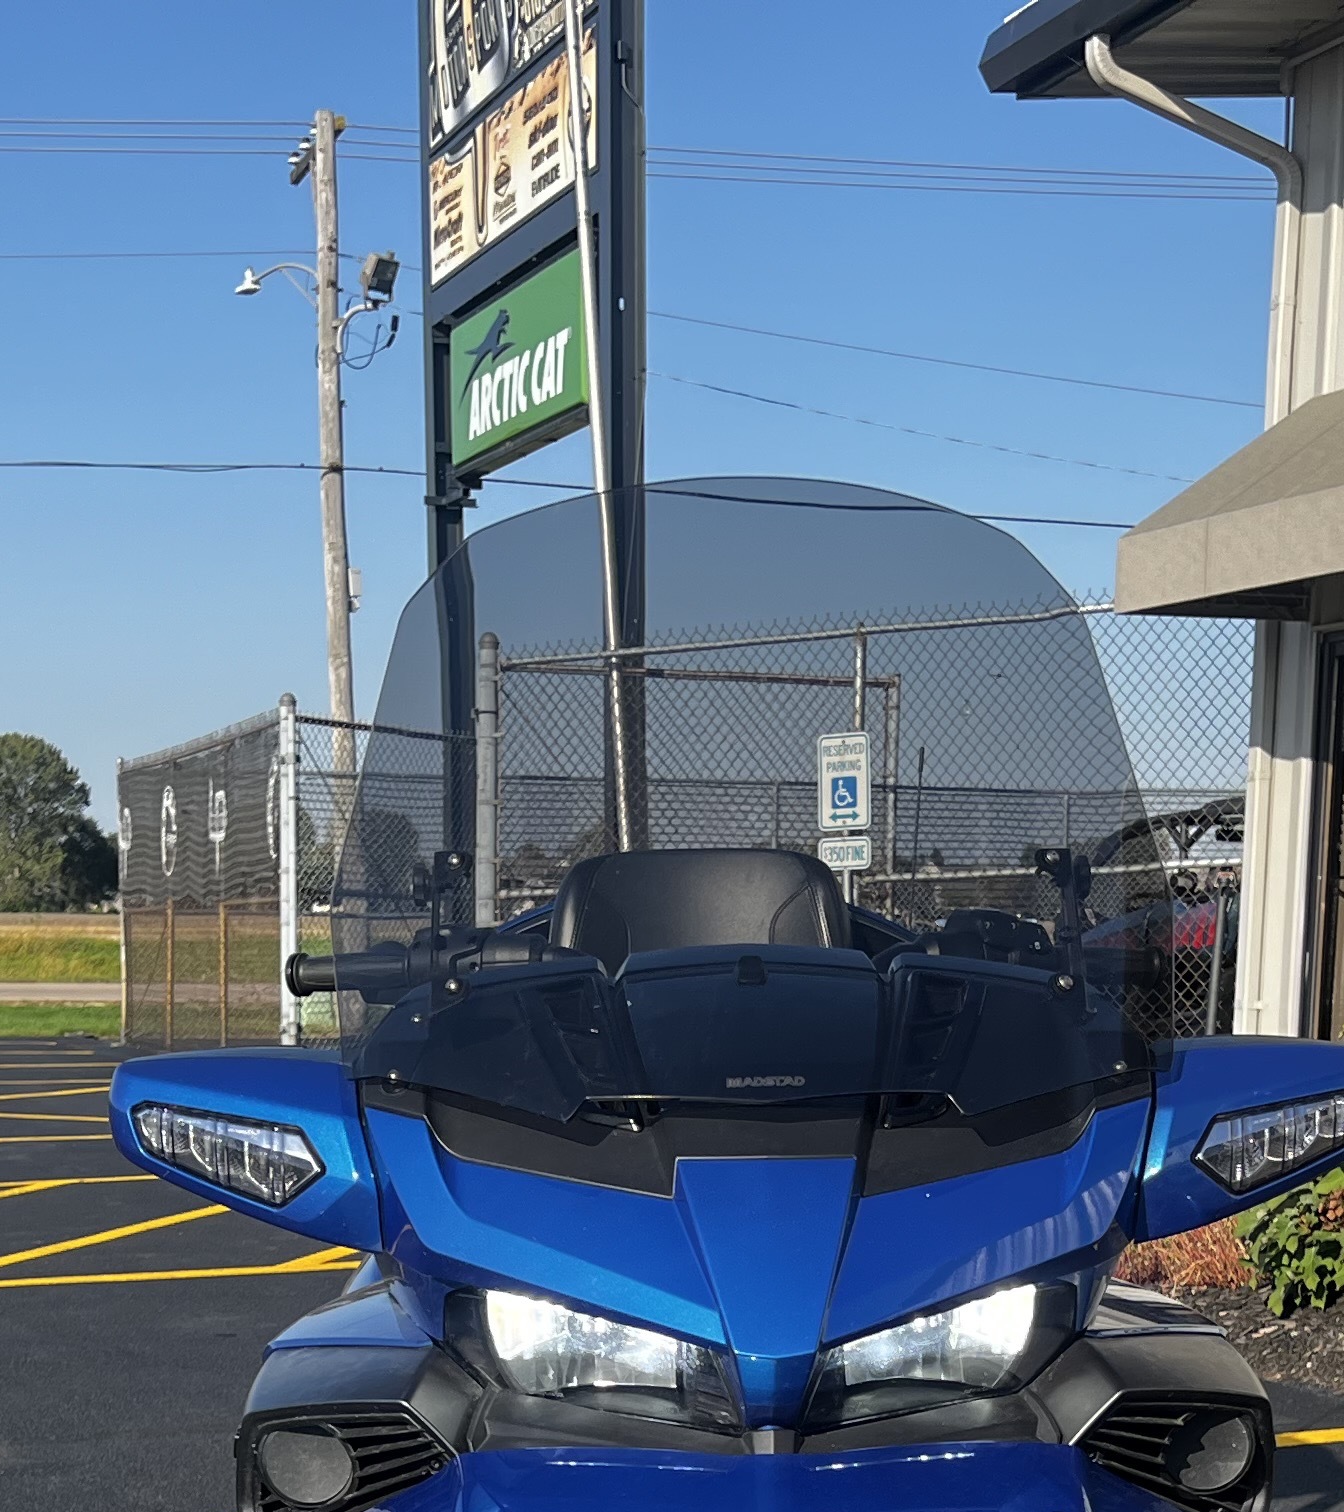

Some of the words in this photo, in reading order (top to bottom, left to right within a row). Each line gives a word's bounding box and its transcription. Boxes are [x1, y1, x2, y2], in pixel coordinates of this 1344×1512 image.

[469, 350, 530, 440] ARCTIC
[531, 328, 570, 406] CAT
[823, 743, 865, 757] RESERVED
[826, 759, 861, 773] PARKING
[824, 846, 845, 863] $350
[846, 845, 866, 861] FINE
